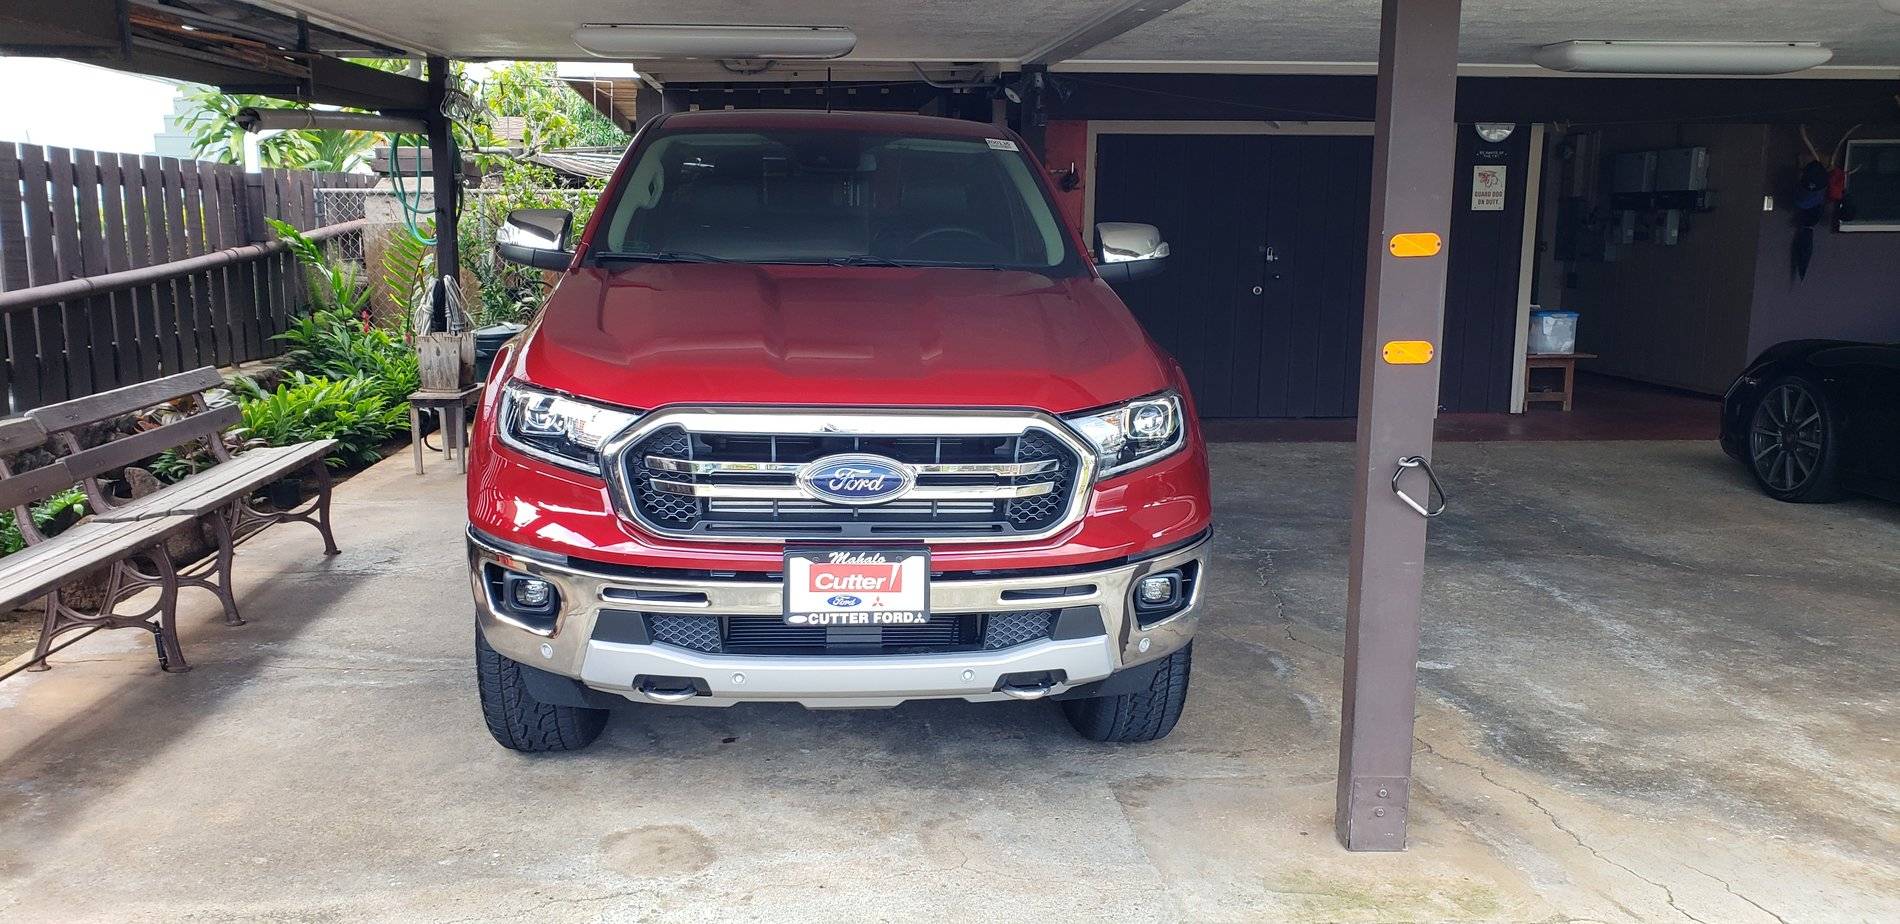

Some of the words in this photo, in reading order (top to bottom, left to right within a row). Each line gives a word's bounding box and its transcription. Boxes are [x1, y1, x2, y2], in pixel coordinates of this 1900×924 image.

[828, 467, 886, 491] Ford
[828, 551, 886, 565] Mahalo
[814, 572, 887, 590] Cutter
[832, 595, 857, 606] Ford
[807, 612, 869, 625] CUTTER
[873, 612, 913, 624] FORD
